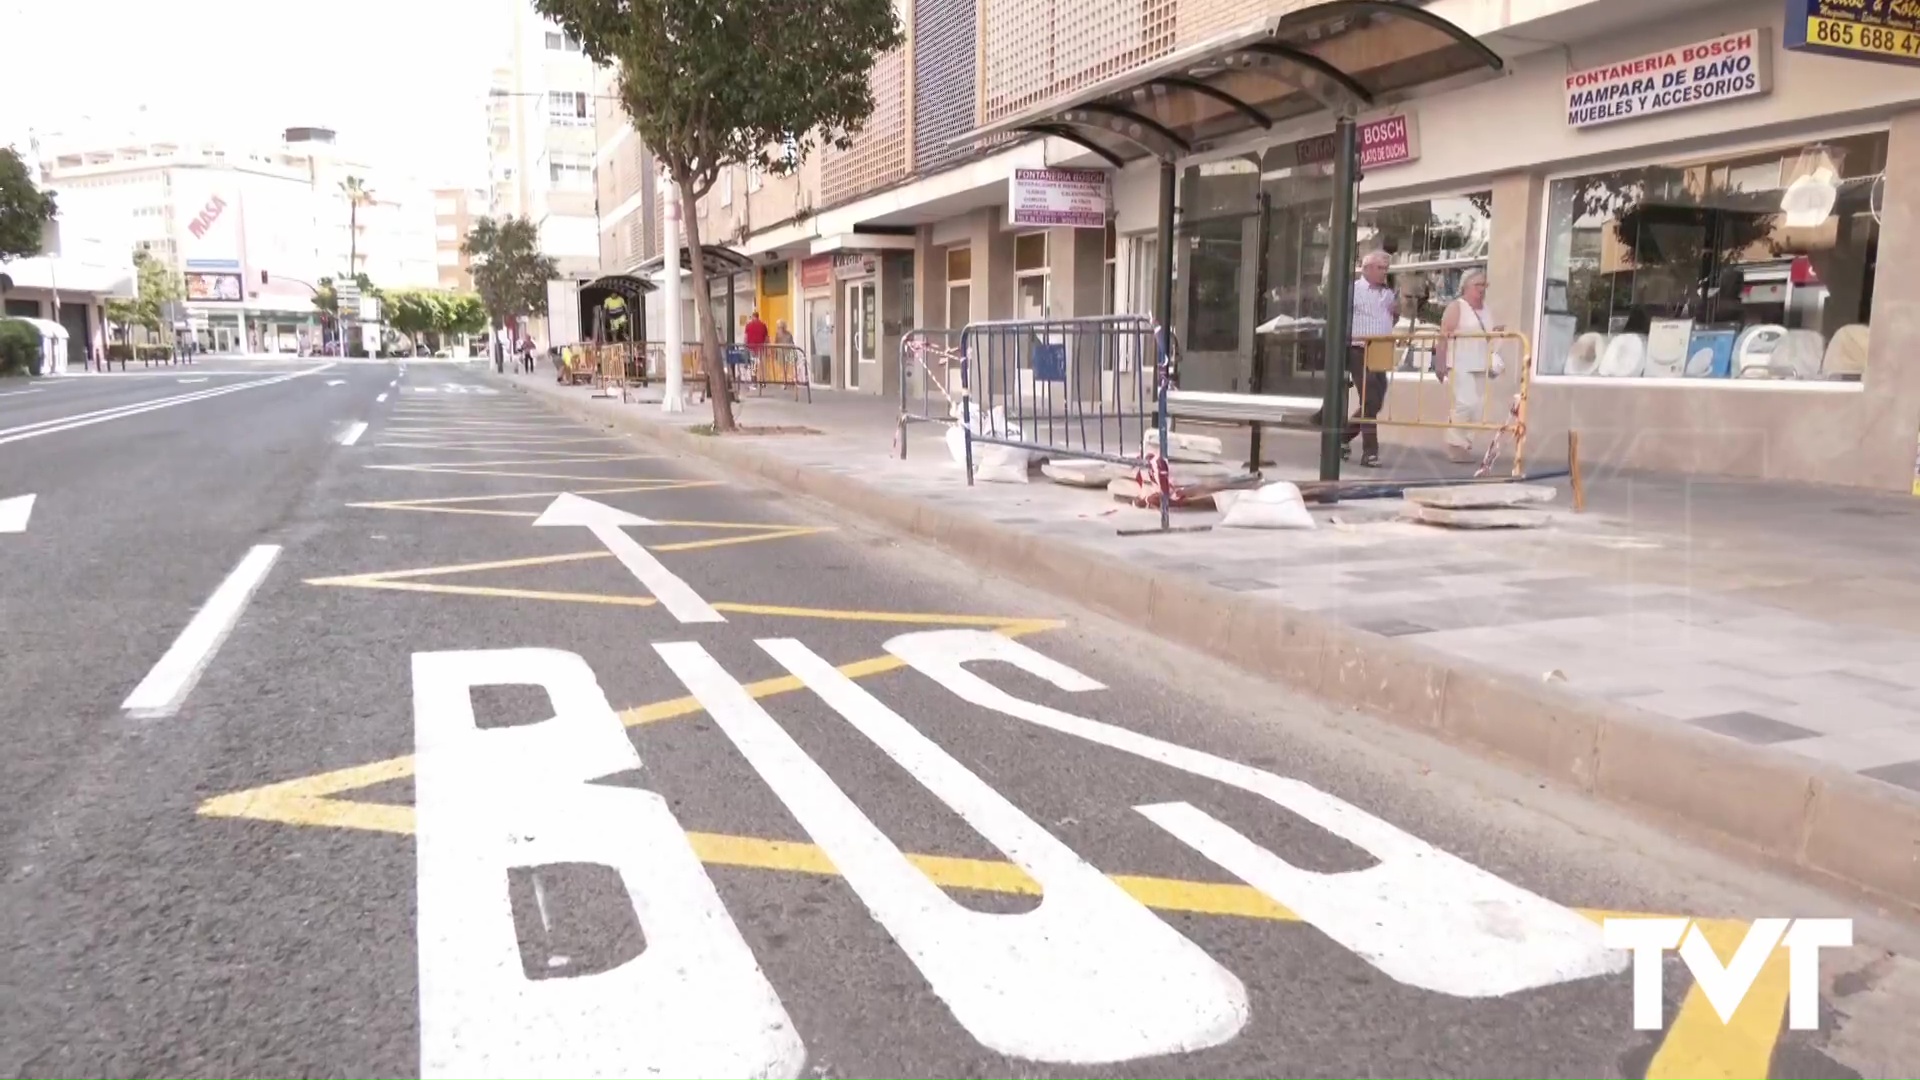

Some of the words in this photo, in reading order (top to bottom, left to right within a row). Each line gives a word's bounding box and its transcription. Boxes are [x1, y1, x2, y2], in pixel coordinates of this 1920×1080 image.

[1817, 20, 1853, 45] 865
[1860, 27, 1894, 51] 688
[1566, 54, 1676, 90] FONTANERIA
[1683, 34, 1751, 62] BOSCH
[1569, 77, 1655, 108] MAMPARA
[1662, 69, 1687, 88] DE
[1693, 55, 1751, 82] BAÑO
[1568, 99, 1633, 125] MUEBLES
[1639, 95, 1649, 110] Y
[1652, 73, 1755, 109] ACCESORIOS
[1364, 119, 1404, 144] BOSCH
[1377, 146, 1385, 160] DE
[1385, 142, 1407, 159] DUCHA
[1017, 170, 1071, 182] FONTANERIA
[1073, 172, 1103, 184] BOSCH
[187, 194, 227, 240] MASA
[411, 629, 1627, 1080] BUS
